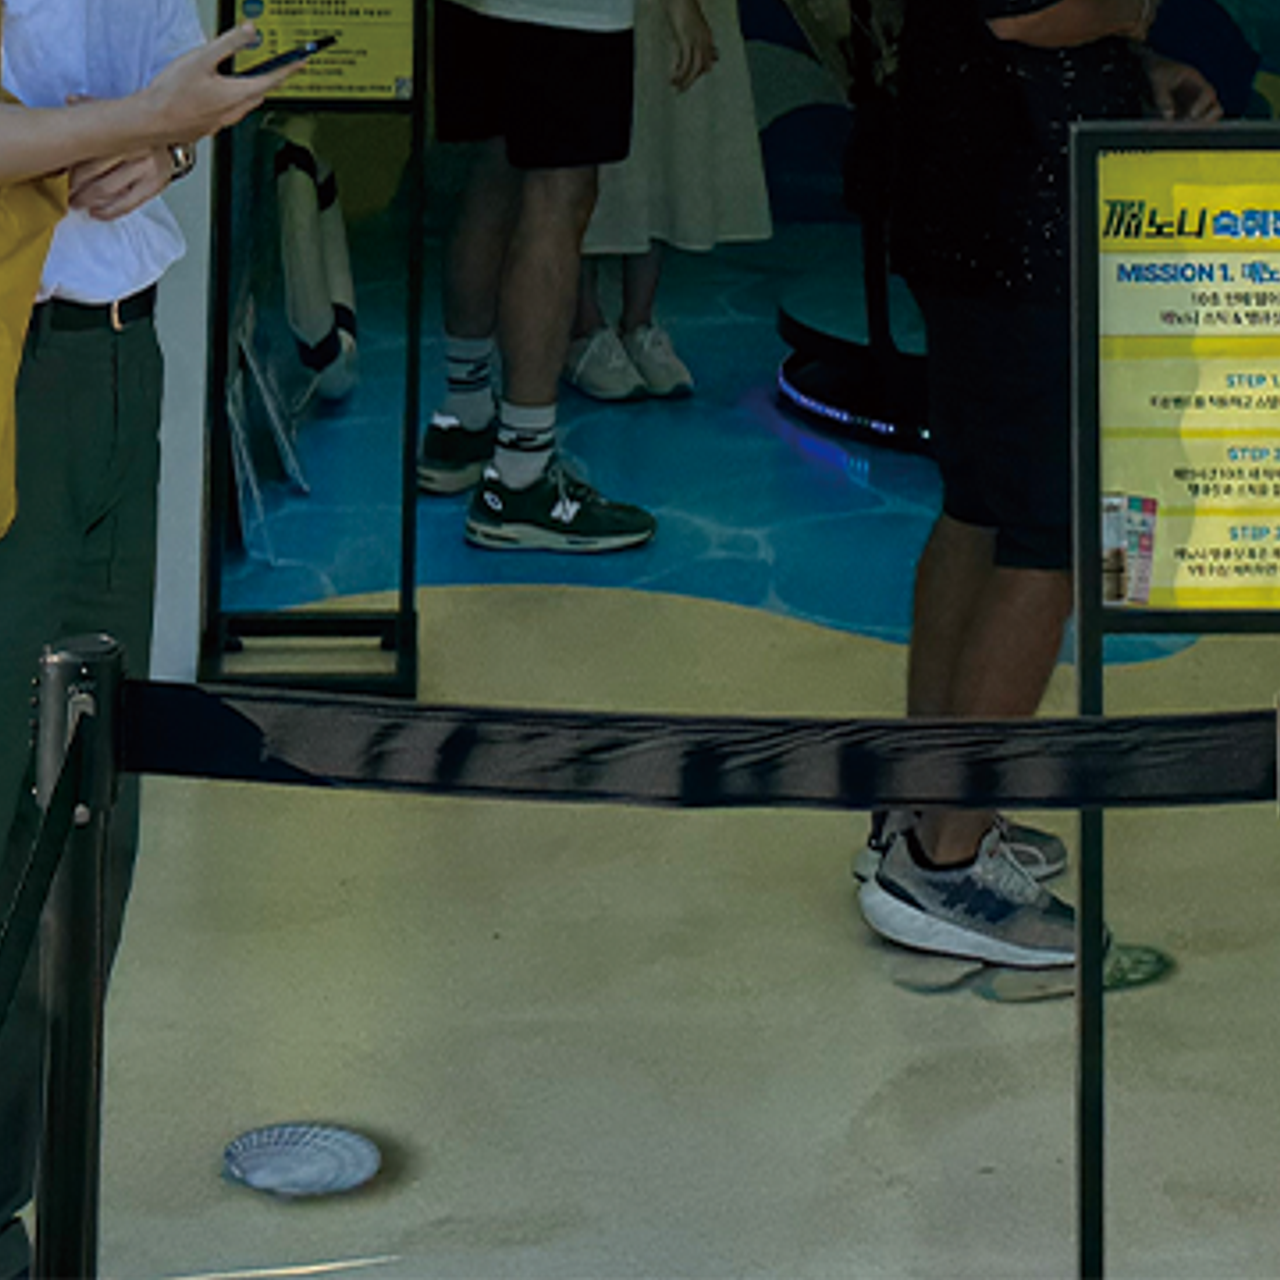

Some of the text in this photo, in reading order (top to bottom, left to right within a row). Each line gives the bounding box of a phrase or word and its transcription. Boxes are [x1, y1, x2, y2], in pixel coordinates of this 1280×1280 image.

[1102, 198, 1207, 239] 깨노니
[1116, 262, 1214, 284] MISSION
[1226, 373, 1267, 389] STEP
